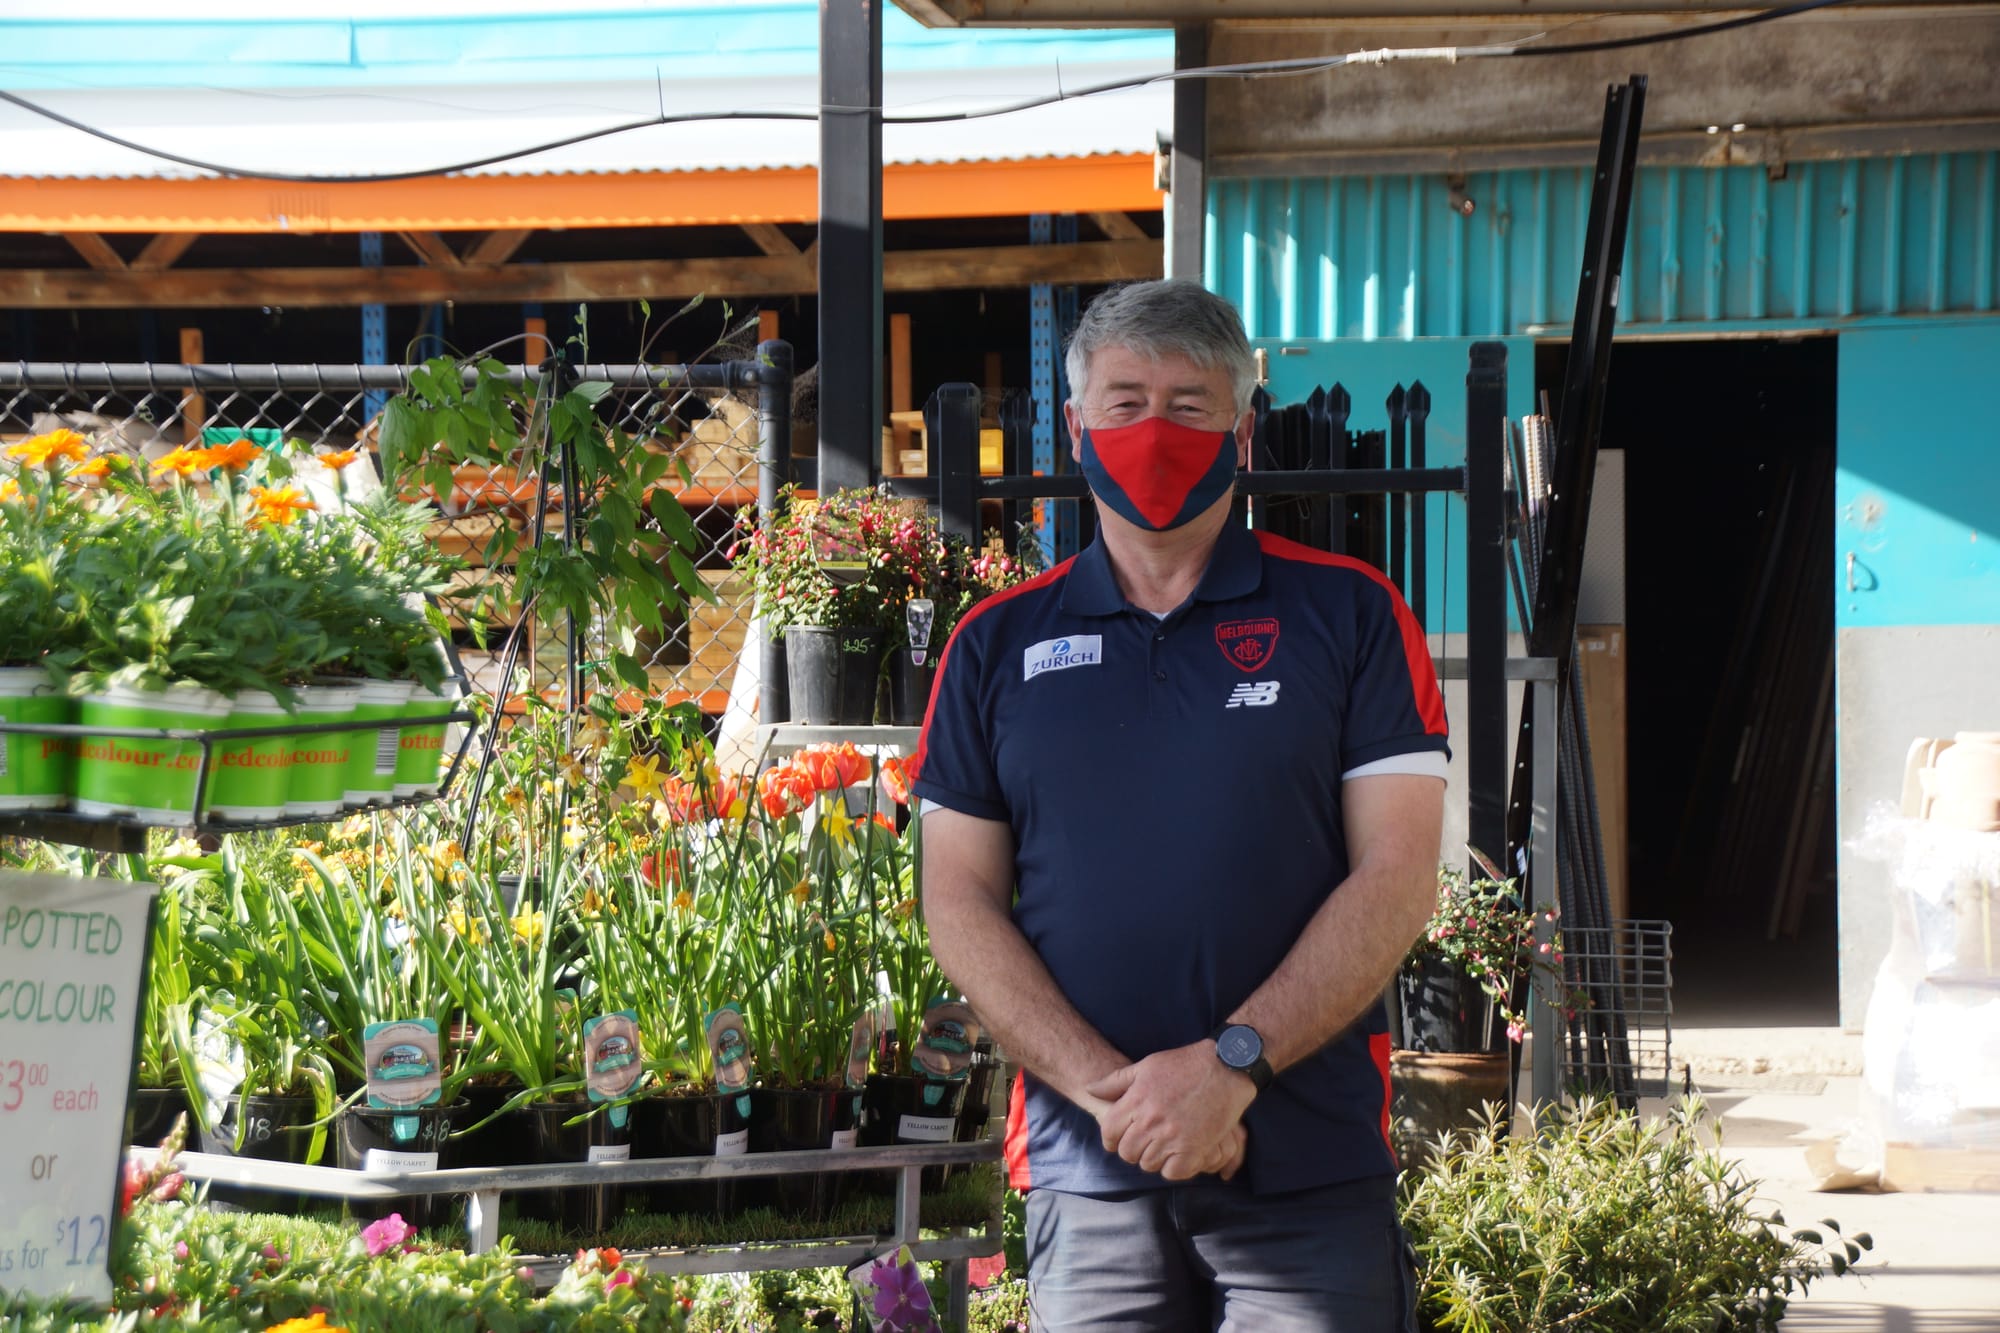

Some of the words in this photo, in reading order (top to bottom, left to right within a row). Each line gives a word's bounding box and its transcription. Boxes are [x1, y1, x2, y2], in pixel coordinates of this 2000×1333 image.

[1219, 623, 1277, 640] MELBOURNE
[1031, 652, 1093, 675] ZURICH
[2, 905, 123, 956] POTTED
[0, 980, 116, 1024] COLOUR
[53, 1080, 99, 1112] each
[31, 1151, 58, 1181] or
[376, 1159, 402, 1167] YELLOW
[21, 1239, 49, 1271] for
[56, 1213, 105, 1268] $12
